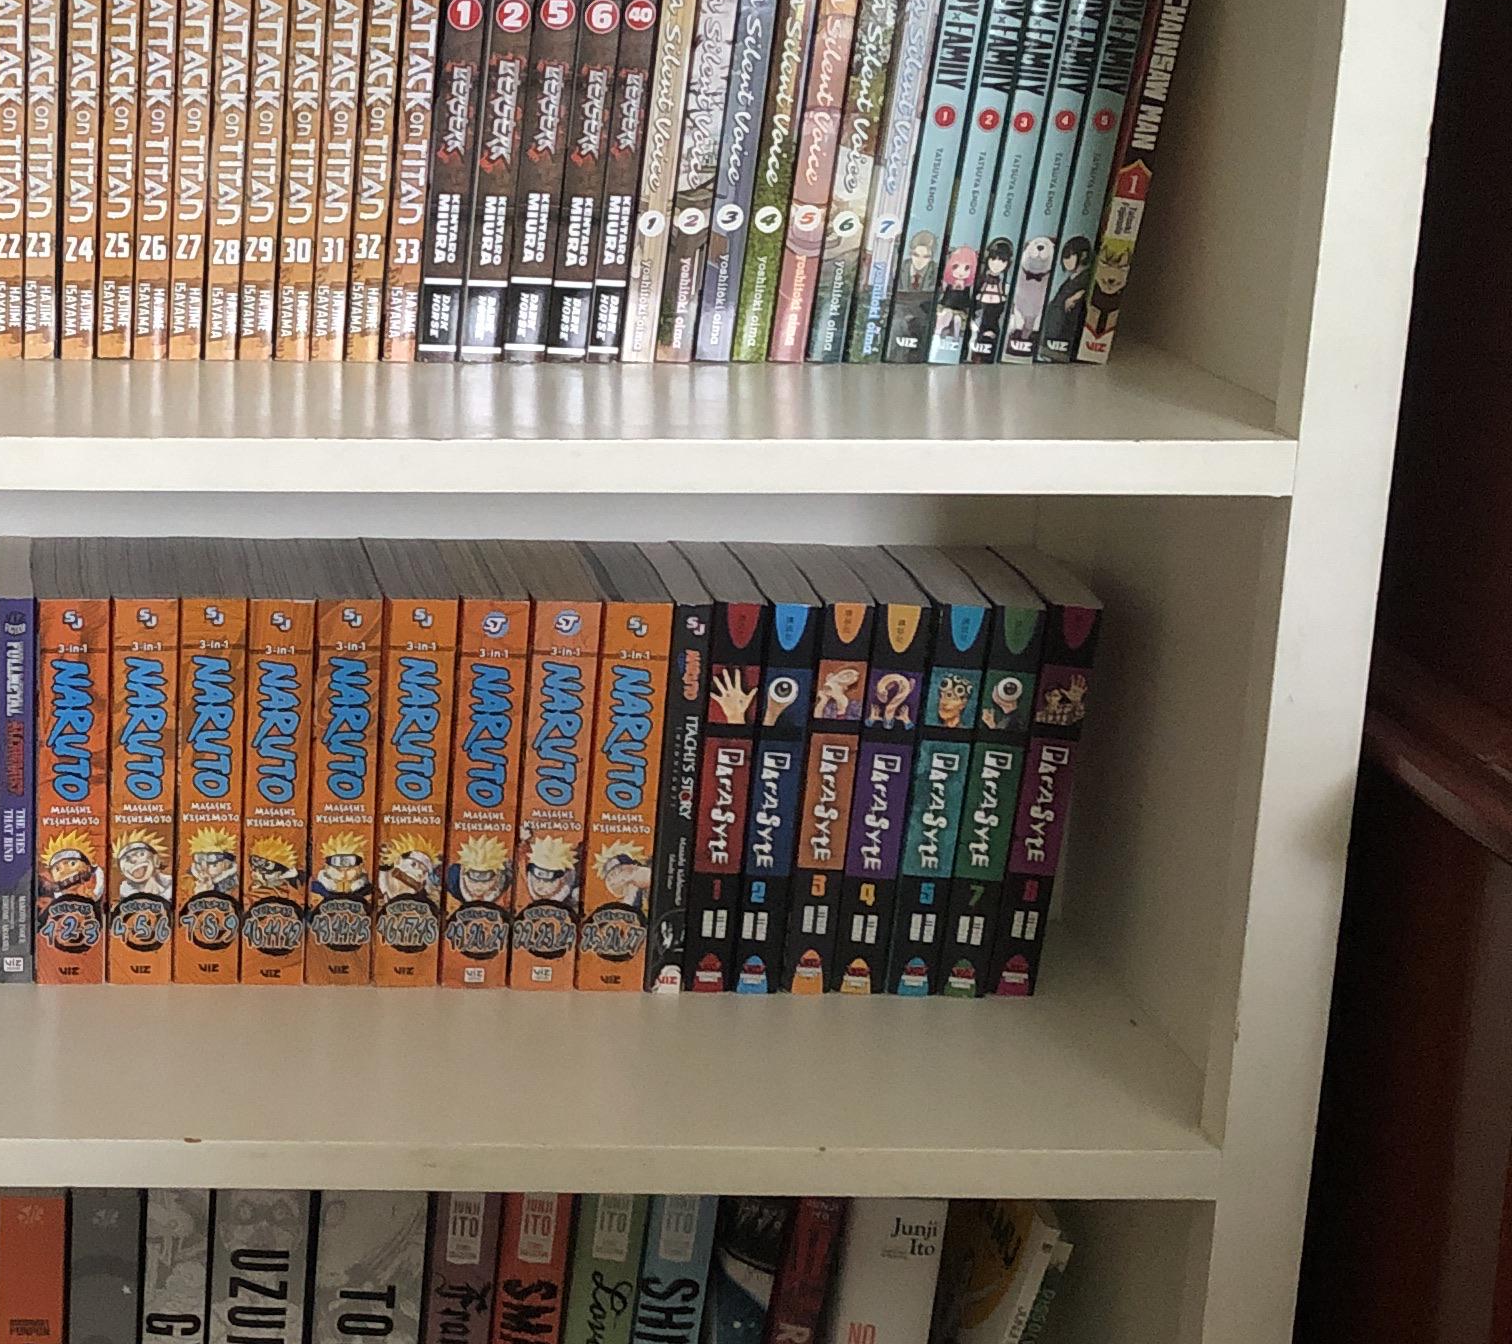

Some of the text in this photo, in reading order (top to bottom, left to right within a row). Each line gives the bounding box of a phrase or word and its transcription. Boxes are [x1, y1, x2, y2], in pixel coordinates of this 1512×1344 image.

[458, 1, 472, 25] 1
[503, 2, 524, 27] 2
[548, 1, 569, 24] 5
[629, 7, 653, 23] 40
[739, 15, 761, 108] Silent
[114, 106, 129, 131] on
[1132, 103, 1164, 150] MAN
[727, 111, 753, 186] Voice
[107, 134, 133, 219] TITAN
[926, 148, 944, 211] TATSUYA ENDO
[1128, 175, 1138, 194] 1
[434, 194, 451, 264] MIURA
[447, 194, 461, 264] KENTARO
[721, 210, 737, 225] 3
[760, 213, 777, 226] 4
[104, 233, 130, 258] 25
[394, 239, 420, 264] 33
[102, 281, 115, 332] ISAYAMA
[429, 294, 439, 337] HORSE
[440, 296, 451, 332] DARK
[896, 337, 918, 348] VIZ
[58, 644, 88, 653] 3-in-1
[6, 641, 24, 716] FULLMETAL
[47, 659, 94, 802] NARUTO
[532, 661, 584, 806] NARUTO
[4, 809, 13, 861] THAT BEND
[16, 809, 25, 854] THE TIES
[751, 881, 766, 903] 2
[59, 967, 80, 975] VIZ
[452, 1215, 479, 1237] ITO
[891, 1217, 937, 1240] Junji
[909, 1239, 935, 1256] Ito
